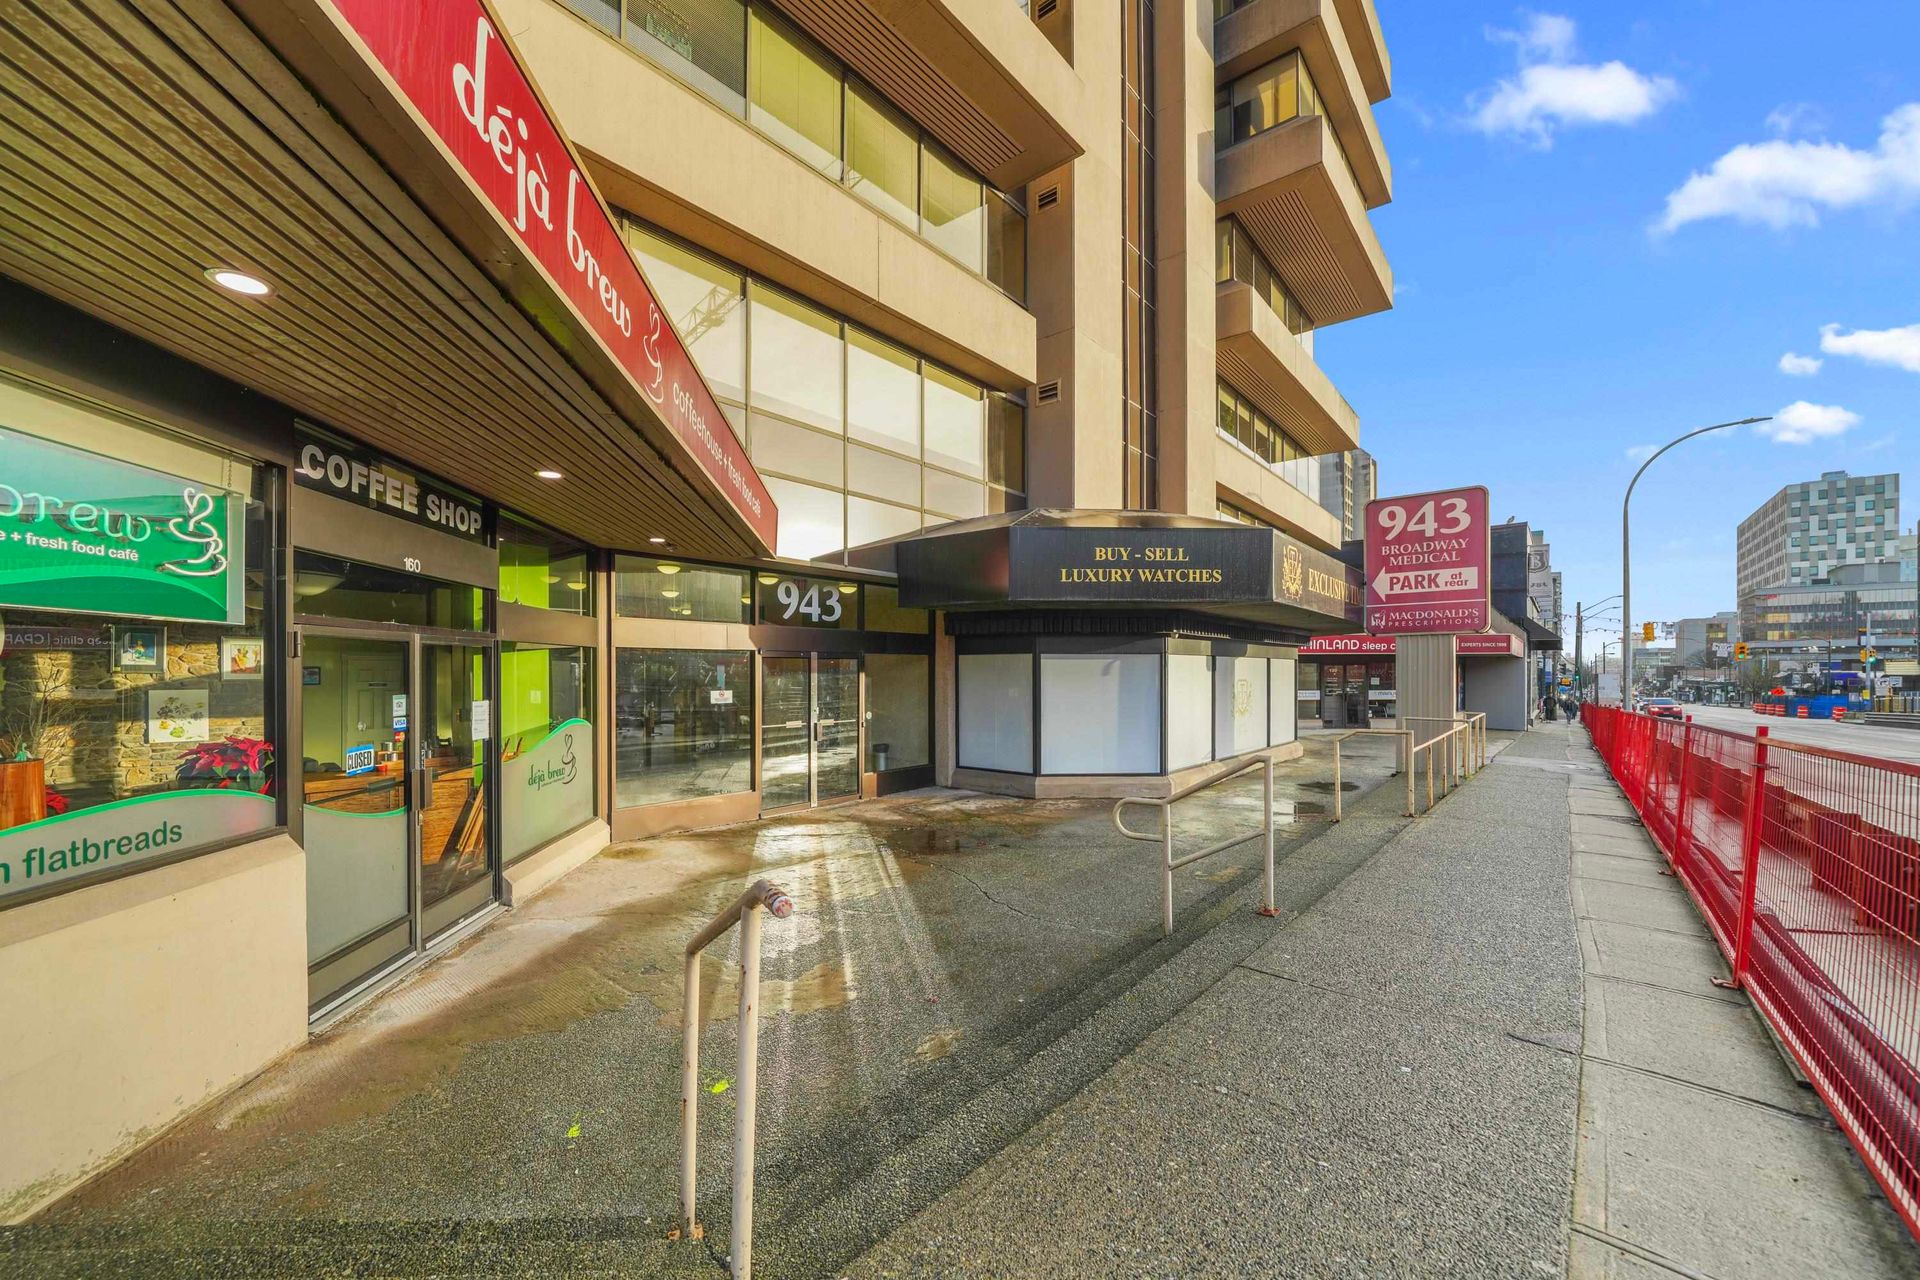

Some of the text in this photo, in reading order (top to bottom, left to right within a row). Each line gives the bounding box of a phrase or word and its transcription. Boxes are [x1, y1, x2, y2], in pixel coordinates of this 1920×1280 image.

[566, 168, 631, 338] brew
[673, 382, 723, 465] coffeehouse
[728, 456, 741, 493] fresh
[741, 476, 752, 507] food
[301, 444, 482, 535] COFFEE SHOP
[1378, 497, 1471, 541] 943
[26, 533, 68, 551] fresh
[72, 538, 105, 556] food
[108, 546, 139, 561] café
[1094, 547, 1132, 561] BUY
[1145, 547, 1189, 562] SELL
[1381, 538, 1469, 556] BROADWAY
[404, 556, 421, 573] 160
[1389, 551, 1461, 566] MEDICAL
[1060, 568, 1222, 583] LUXURY WATCHES
[1389, 573, 1440, 591] PARK
[1444, 579, 1469, 587] rear
[1450, 572, 1462, 580] at
[1308, 568, 1349, 602] EXCLUSIVE
[777, 581, 842, 622] 943
[1388, 618, 1480, 627] PRESCRIPTIONS
[1389, 608, 1479, 620] MACDONALD'S
[1301, 639, 1359, 650] INLAND
[1362, 641, 1387, 652] sleep
[347, 750, 372, 770] CLOSED
[22, 821, 183, 878] flatbreads
